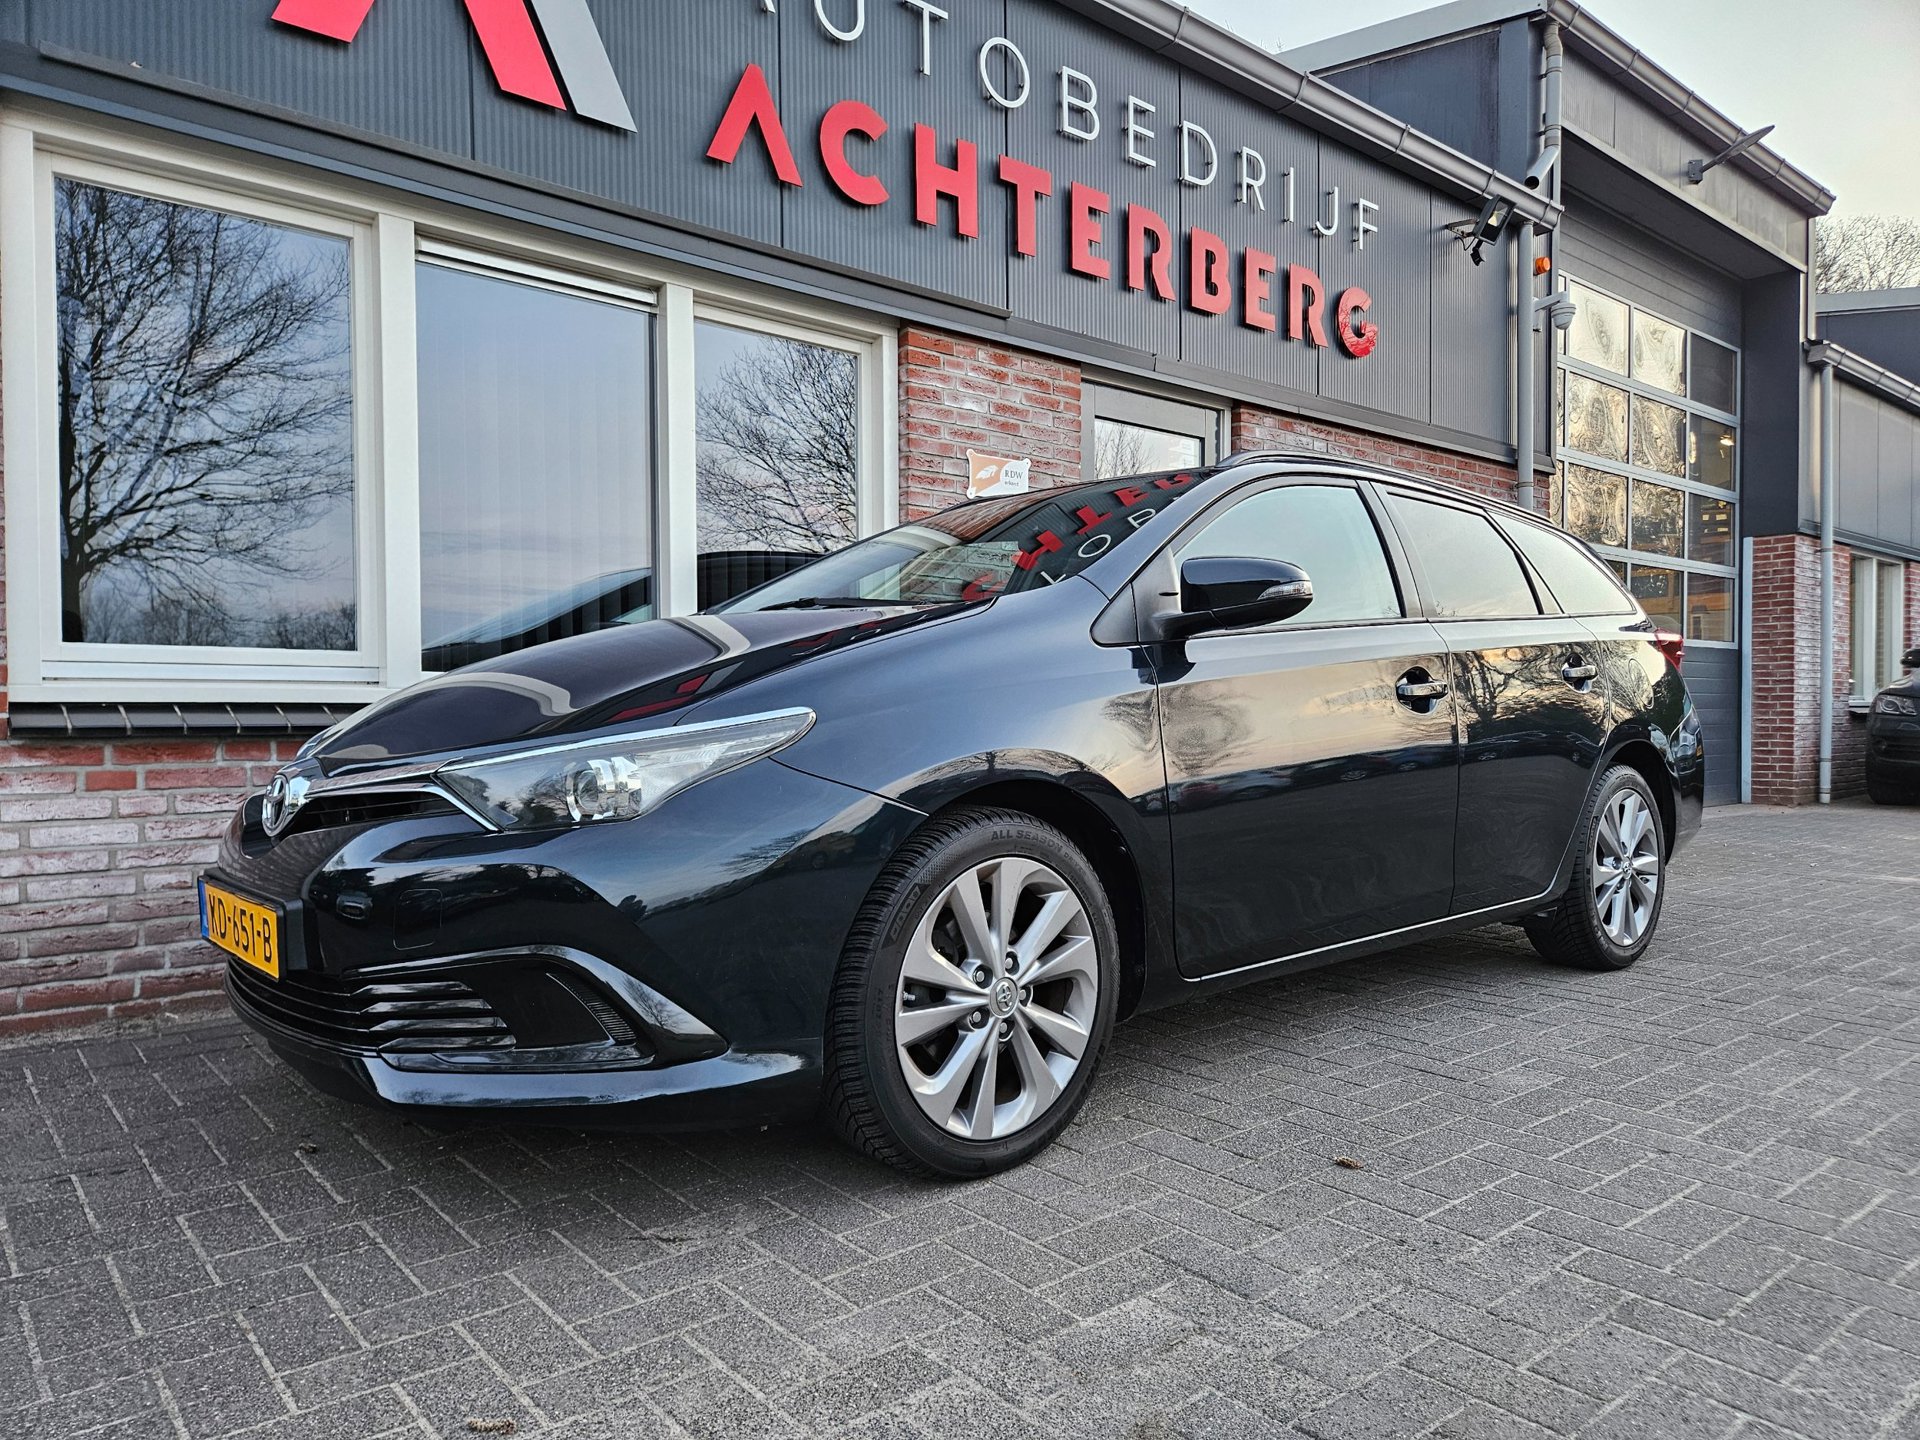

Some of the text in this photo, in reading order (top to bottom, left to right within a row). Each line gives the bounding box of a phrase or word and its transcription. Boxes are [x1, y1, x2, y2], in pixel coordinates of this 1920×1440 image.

[763, 0, 1379, 250] UTOBEDRIJF
[706, 63, 1379, 359] ACHTERBERG
[1004, 469, 1024, 480] RDW
[991, 829, 1013, 841] ALL
[1016, 829, 1063, 853] SEASON
